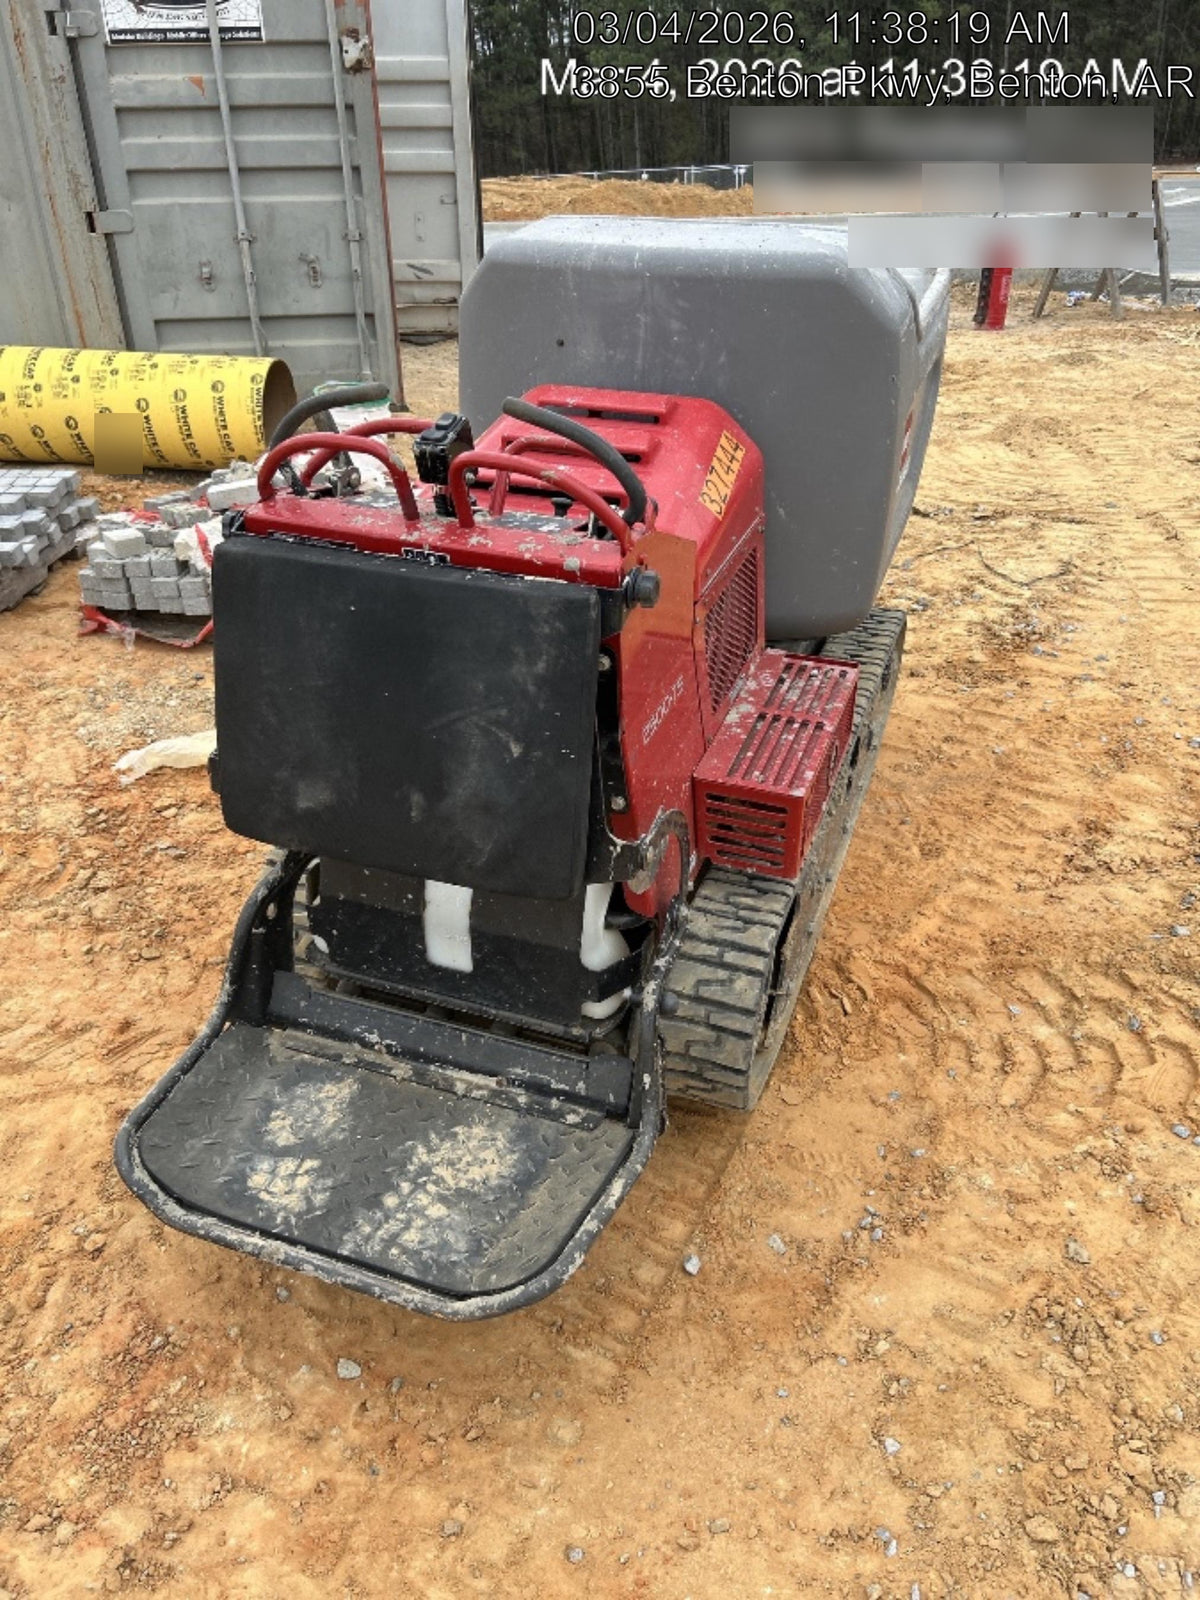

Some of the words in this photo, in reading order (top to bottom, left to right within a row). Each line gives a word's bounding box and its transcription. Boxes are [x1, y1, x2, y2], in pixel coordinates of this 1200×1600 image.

[180, 404, 193, 440] WHITE
[217, 396, 228, 432] WHITE
[701, 433, 744, 514] 327444
